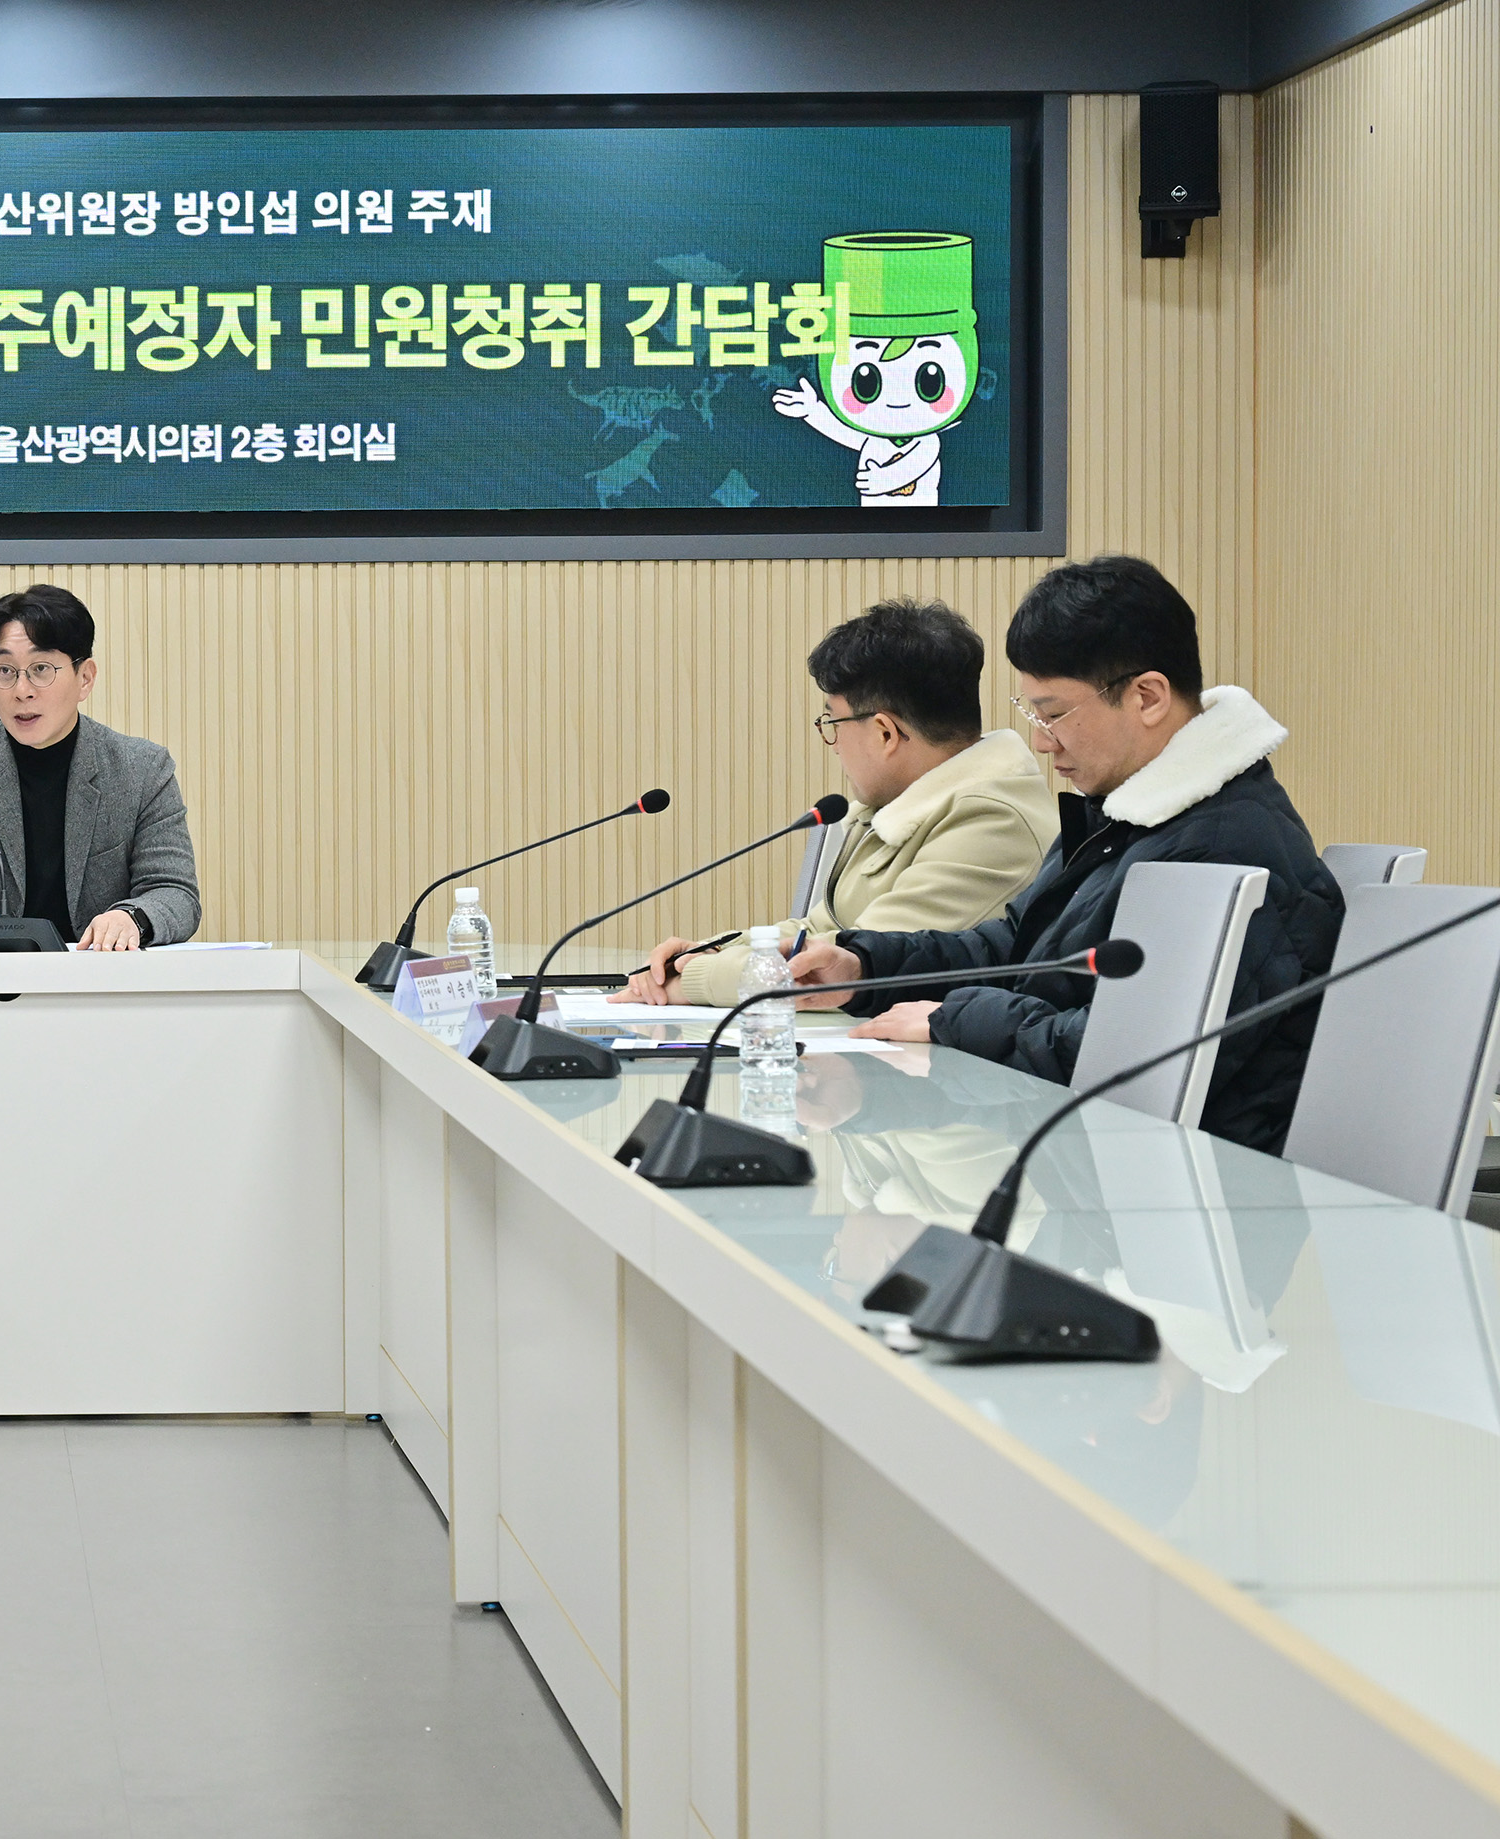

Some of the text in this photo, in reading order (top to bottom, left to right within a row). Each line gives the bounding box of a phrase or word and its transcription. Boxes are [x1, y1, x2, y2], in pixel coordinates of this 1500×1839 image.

[174, 190, 297, 236] 방인섭
[311, 189, 393, 235] 의원
[407, 188, 492, 234] 주재
[301, 283, 601, 370] 민원청취
[625, 281, 850, 367] 간담회
[231, 423, 287, 463] 2층
[293, 422, 396, 462] 회의실
